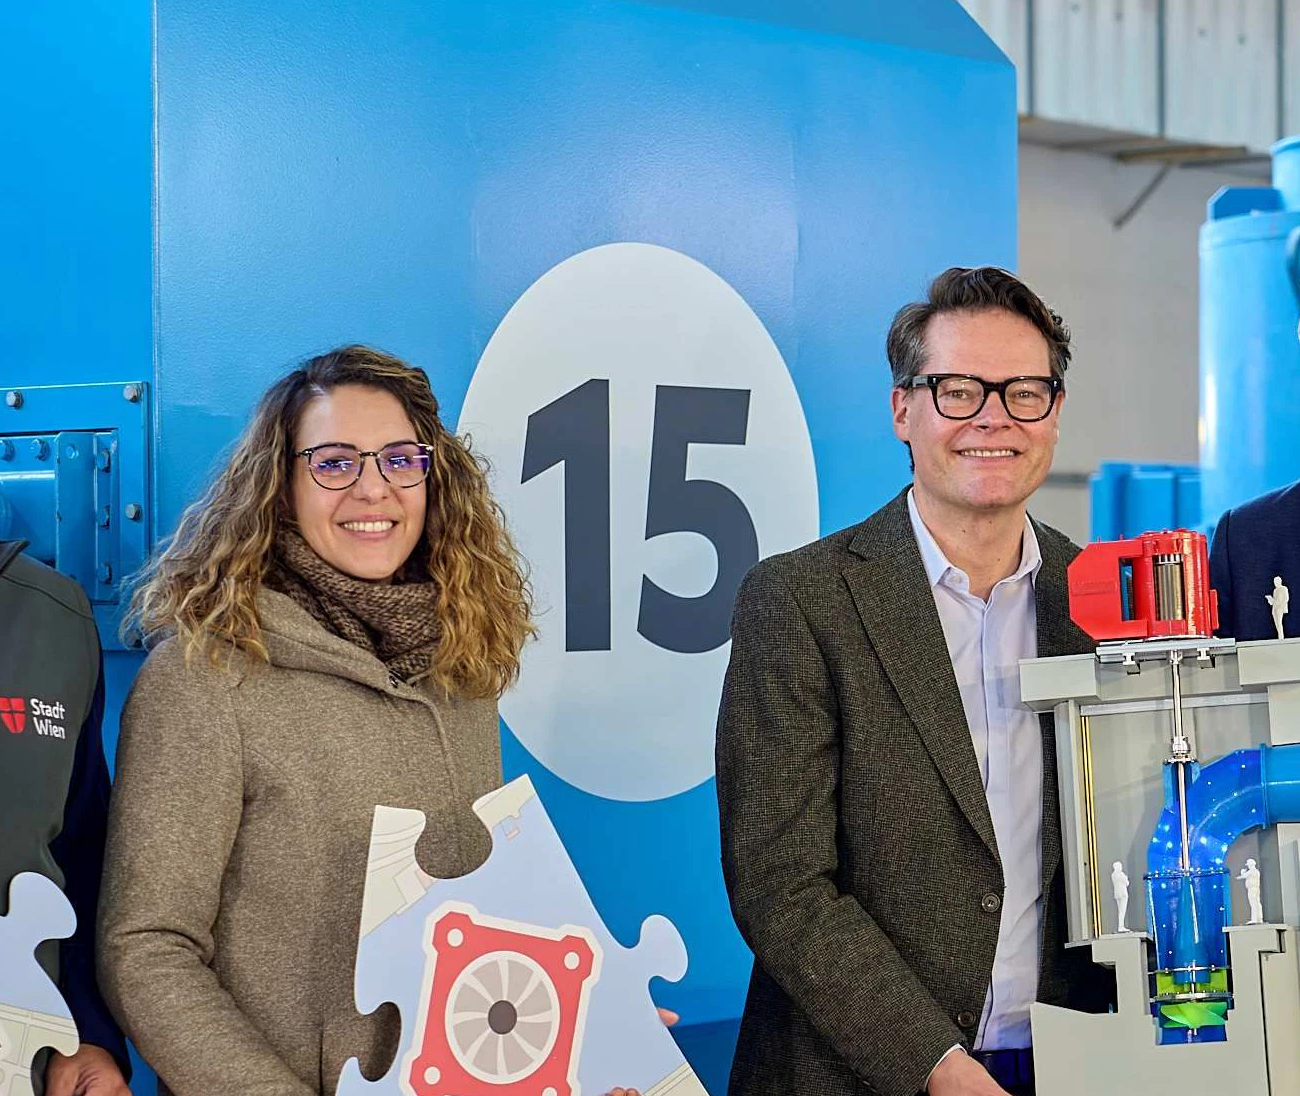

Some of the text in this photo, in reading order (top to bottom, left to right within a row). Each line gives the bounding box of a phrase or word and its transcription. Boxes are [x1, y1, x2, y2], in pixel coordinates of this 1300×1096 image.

[521, 378, 760, 655] 15
[30, 698, 66, 720] Stadt
[33, 716, 66, 740] Wien
